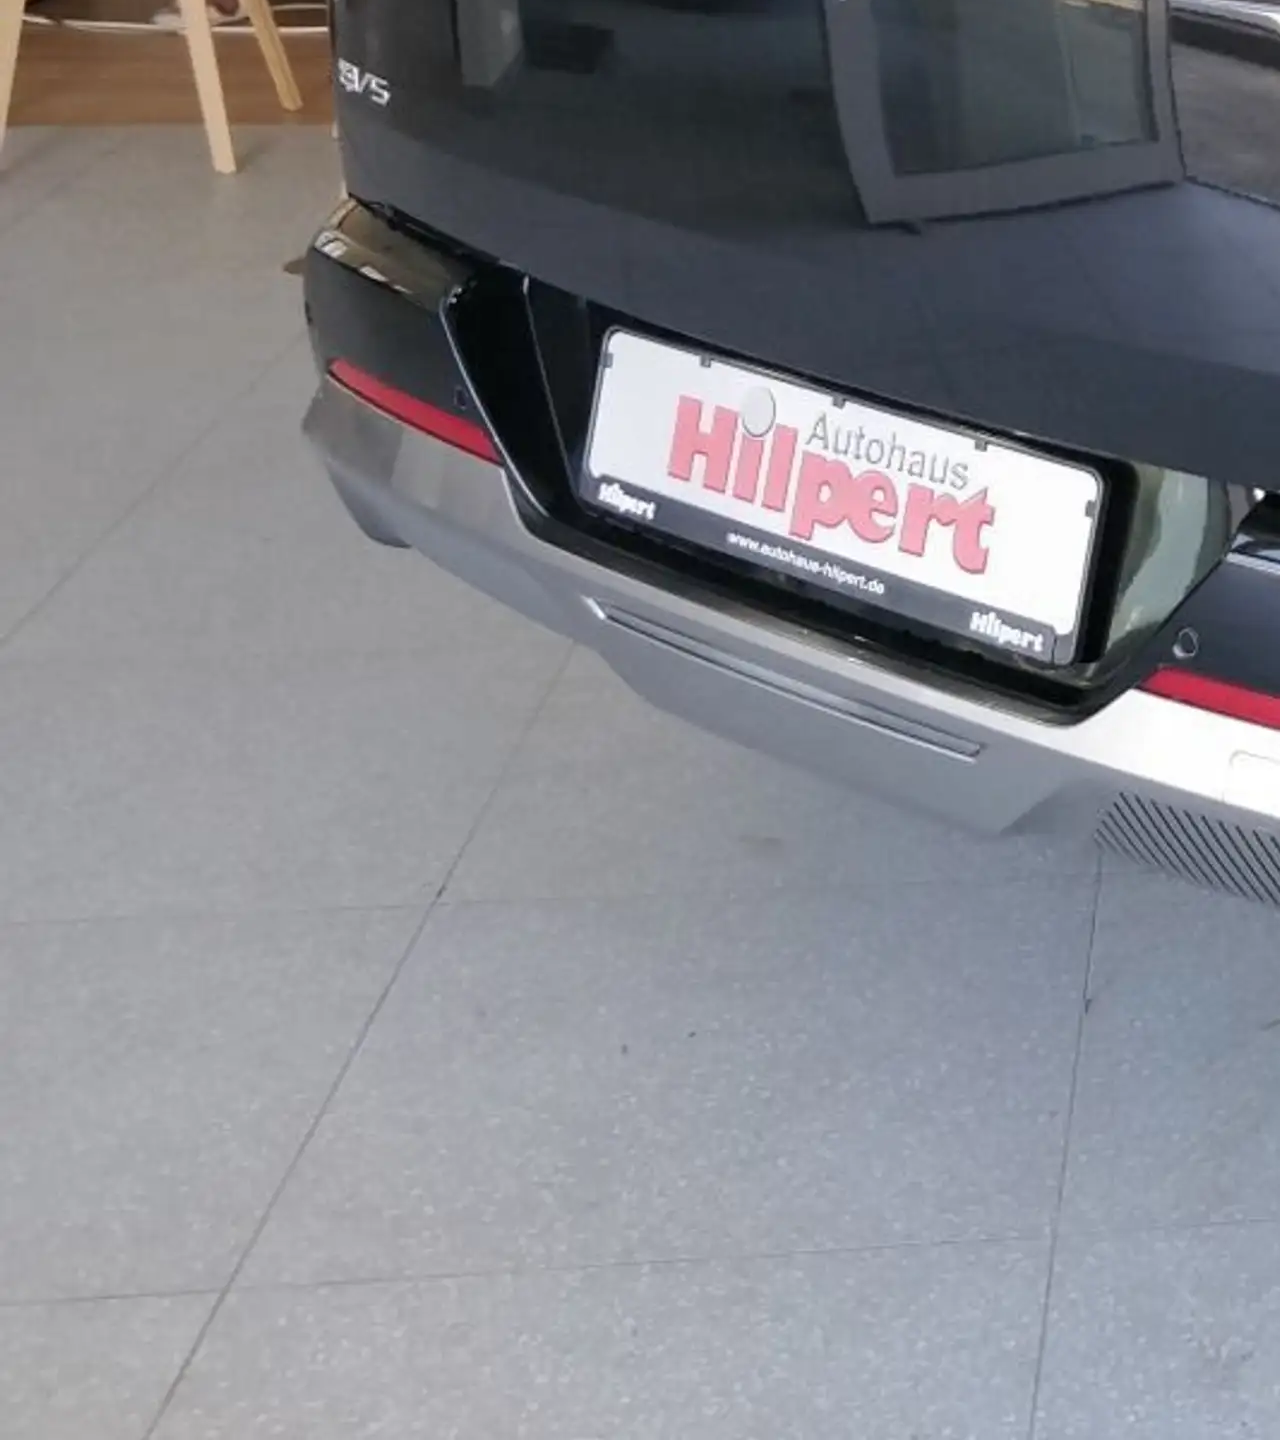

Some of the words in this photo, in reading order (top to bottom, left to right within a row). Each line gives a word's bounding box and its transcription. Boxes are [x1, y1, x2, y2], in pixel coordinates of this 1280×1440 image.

[668, 386, 996, 575] Hilpert
[804, 411, 970, 490] Autohaus
[597, 481, 657, 520] Hilpert
[727, 533, 886, 596] www.autohaus-hilpert.de
[969, 611, 1045, 653] Hilpert
